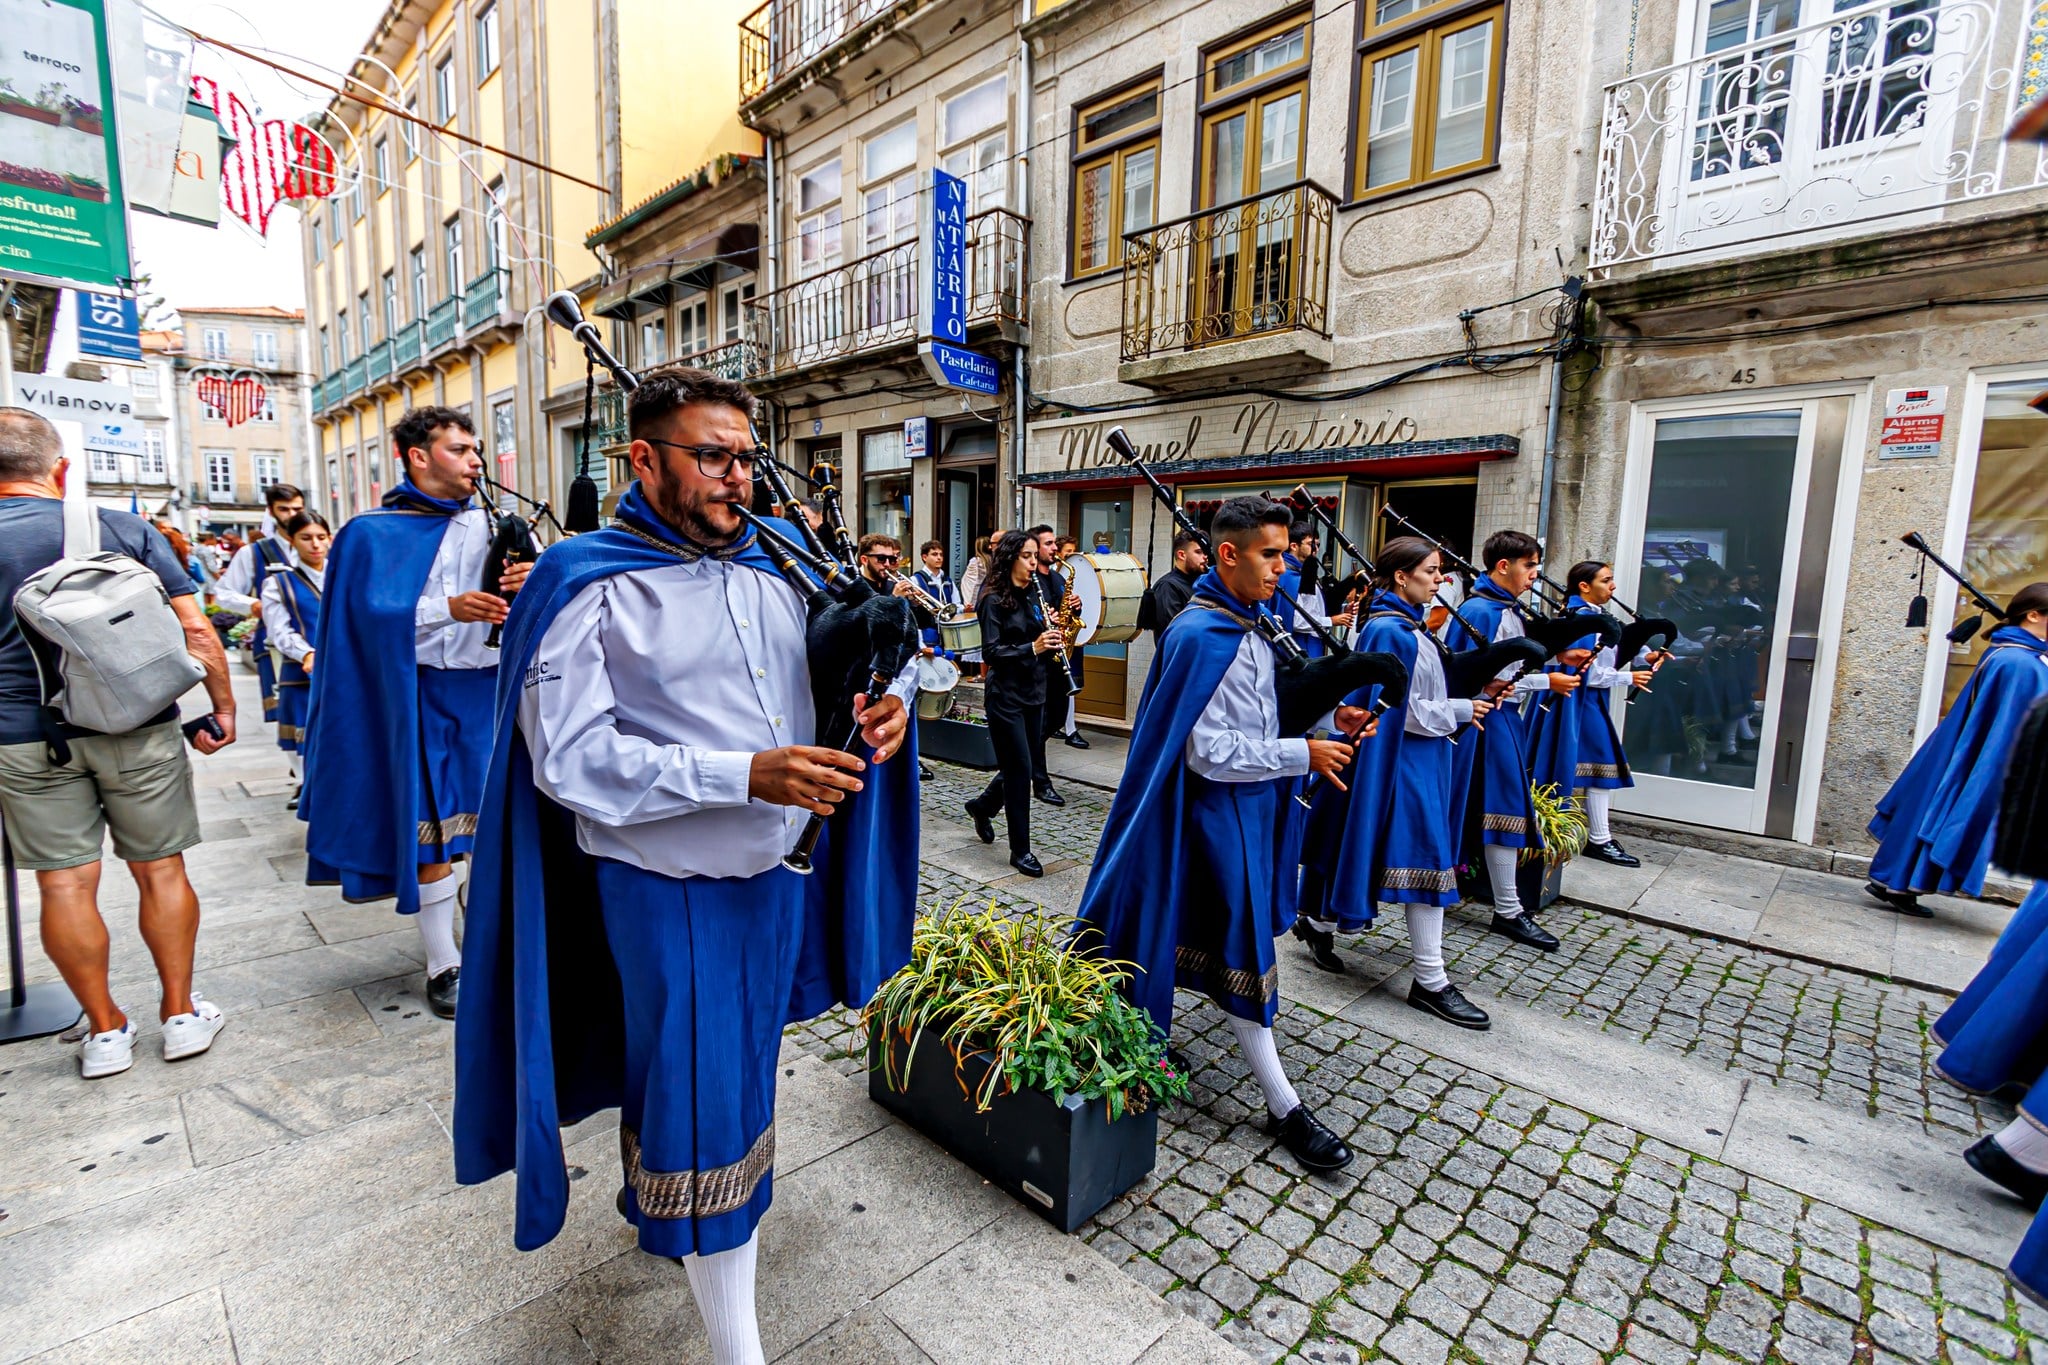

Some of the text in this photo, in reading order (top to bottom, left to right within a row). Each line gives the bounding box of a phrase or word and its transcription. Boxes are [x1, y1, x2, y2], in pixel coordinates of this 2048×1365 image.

[23, 50, 80, 73] terraço
[936, 209, 946, 301] MANUEL
[947, 180, 962, 337] NATÁRIO
[941, 349, 995, 376] Pastelaria
[960, 373, 995, 390] Cafetaria
[1731, 368, 1756, 384] 45
[21, 388, 131, 414] Vilanova
[1889, 418, 1939, 427] Alarme
[89, 436, 137, 449] ZURICH
